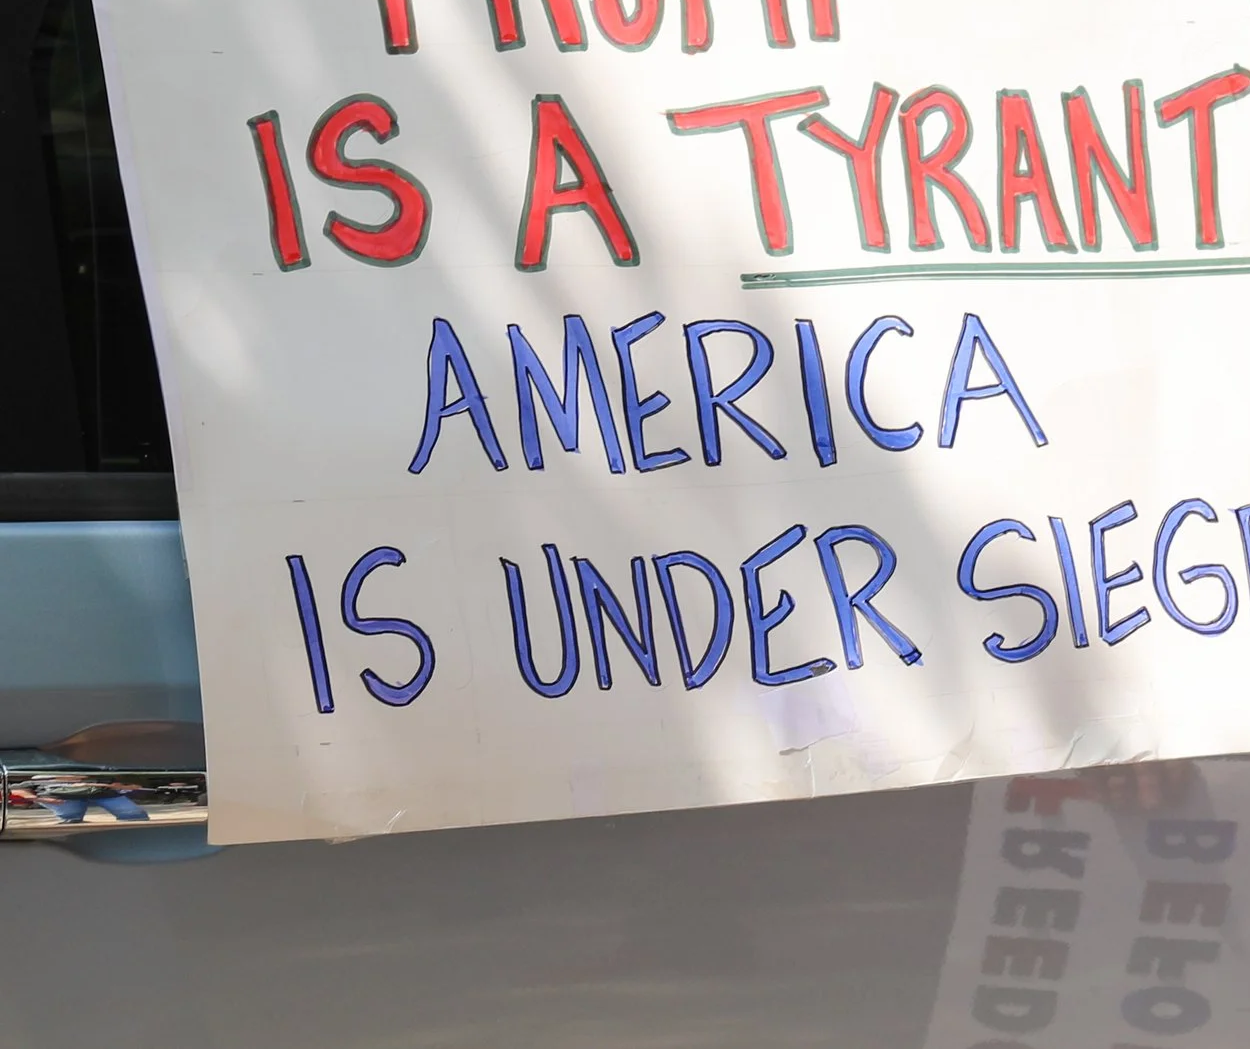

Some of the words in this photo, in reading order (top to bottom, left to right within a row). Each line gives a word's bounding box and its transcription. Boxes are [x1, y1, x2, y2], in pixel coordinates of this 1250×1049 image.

[246, 92, 433, 273] IS
[513, 94, 641, 273] A
[407, 312, 1049, 475] AMERICA
[284, 546, 435, 714] IS
[500, 523, 924, 700] UNDER
